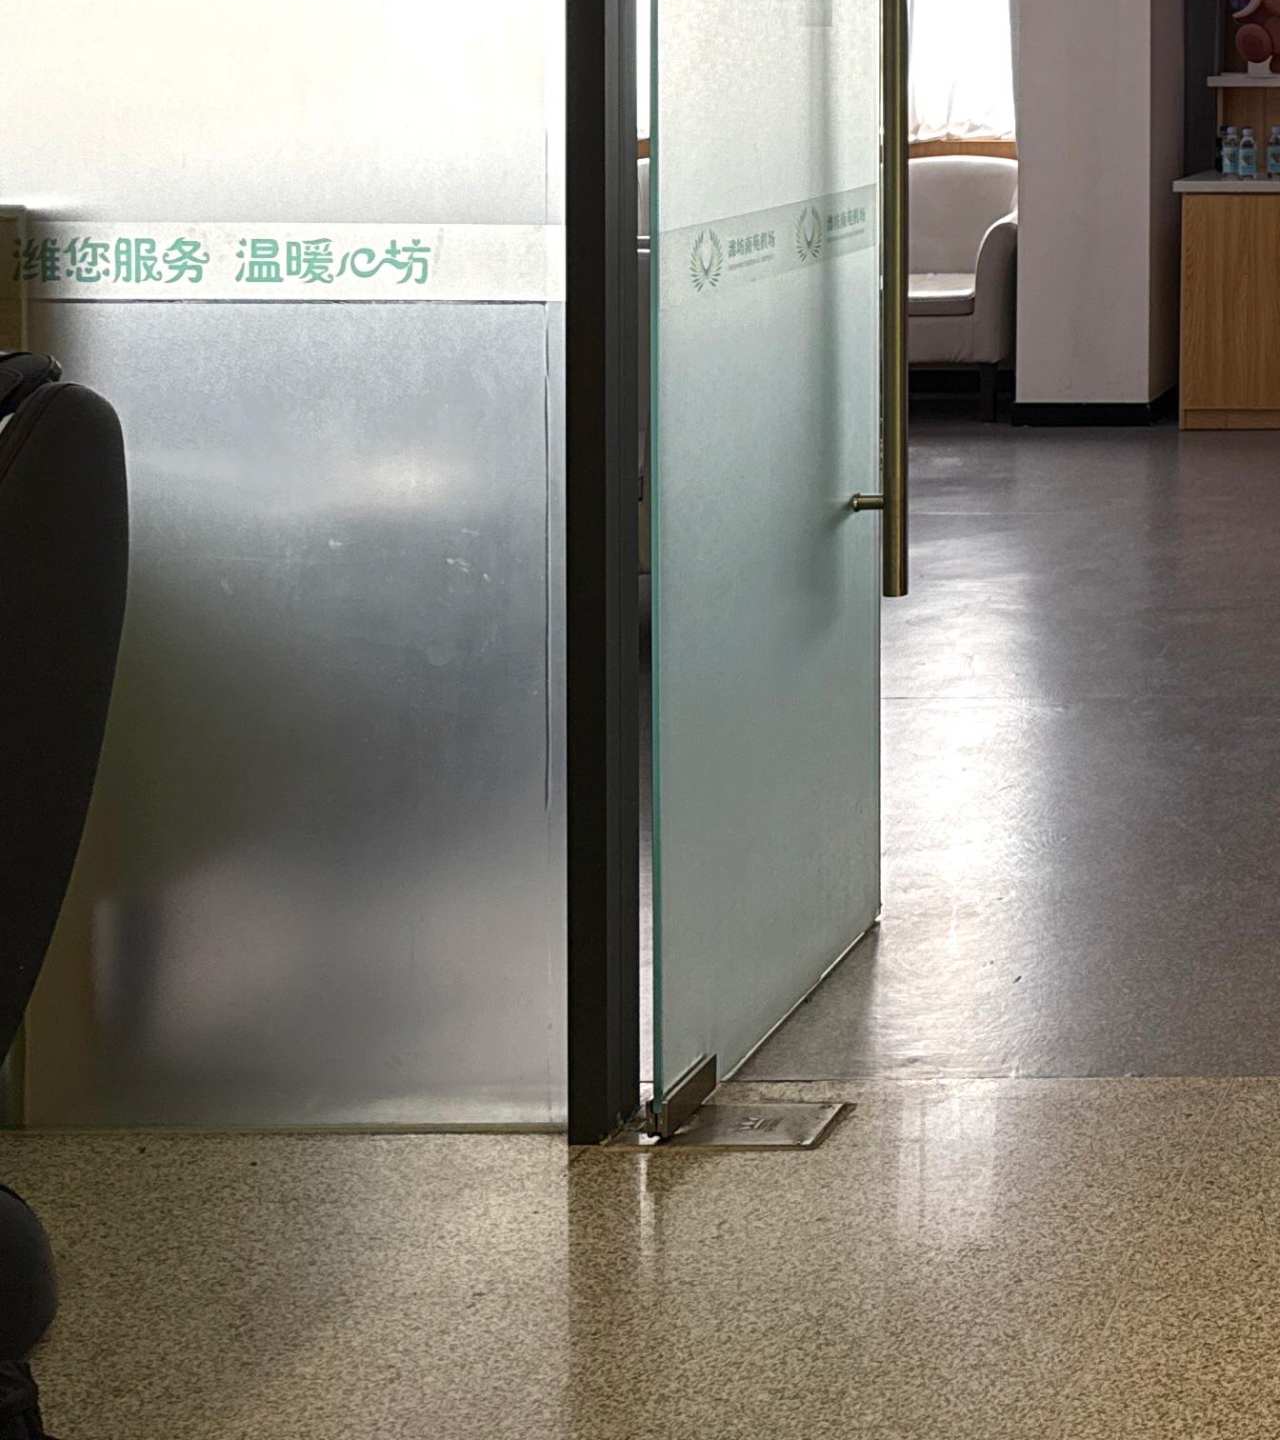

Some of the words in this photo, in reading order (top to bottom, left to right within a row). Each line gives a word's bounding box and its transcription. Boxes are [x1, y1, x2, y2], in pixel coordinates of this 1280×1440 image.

[13, 236, 212, 284] 潍您服务
[236, 237, 431, 285] 温暖心坊
